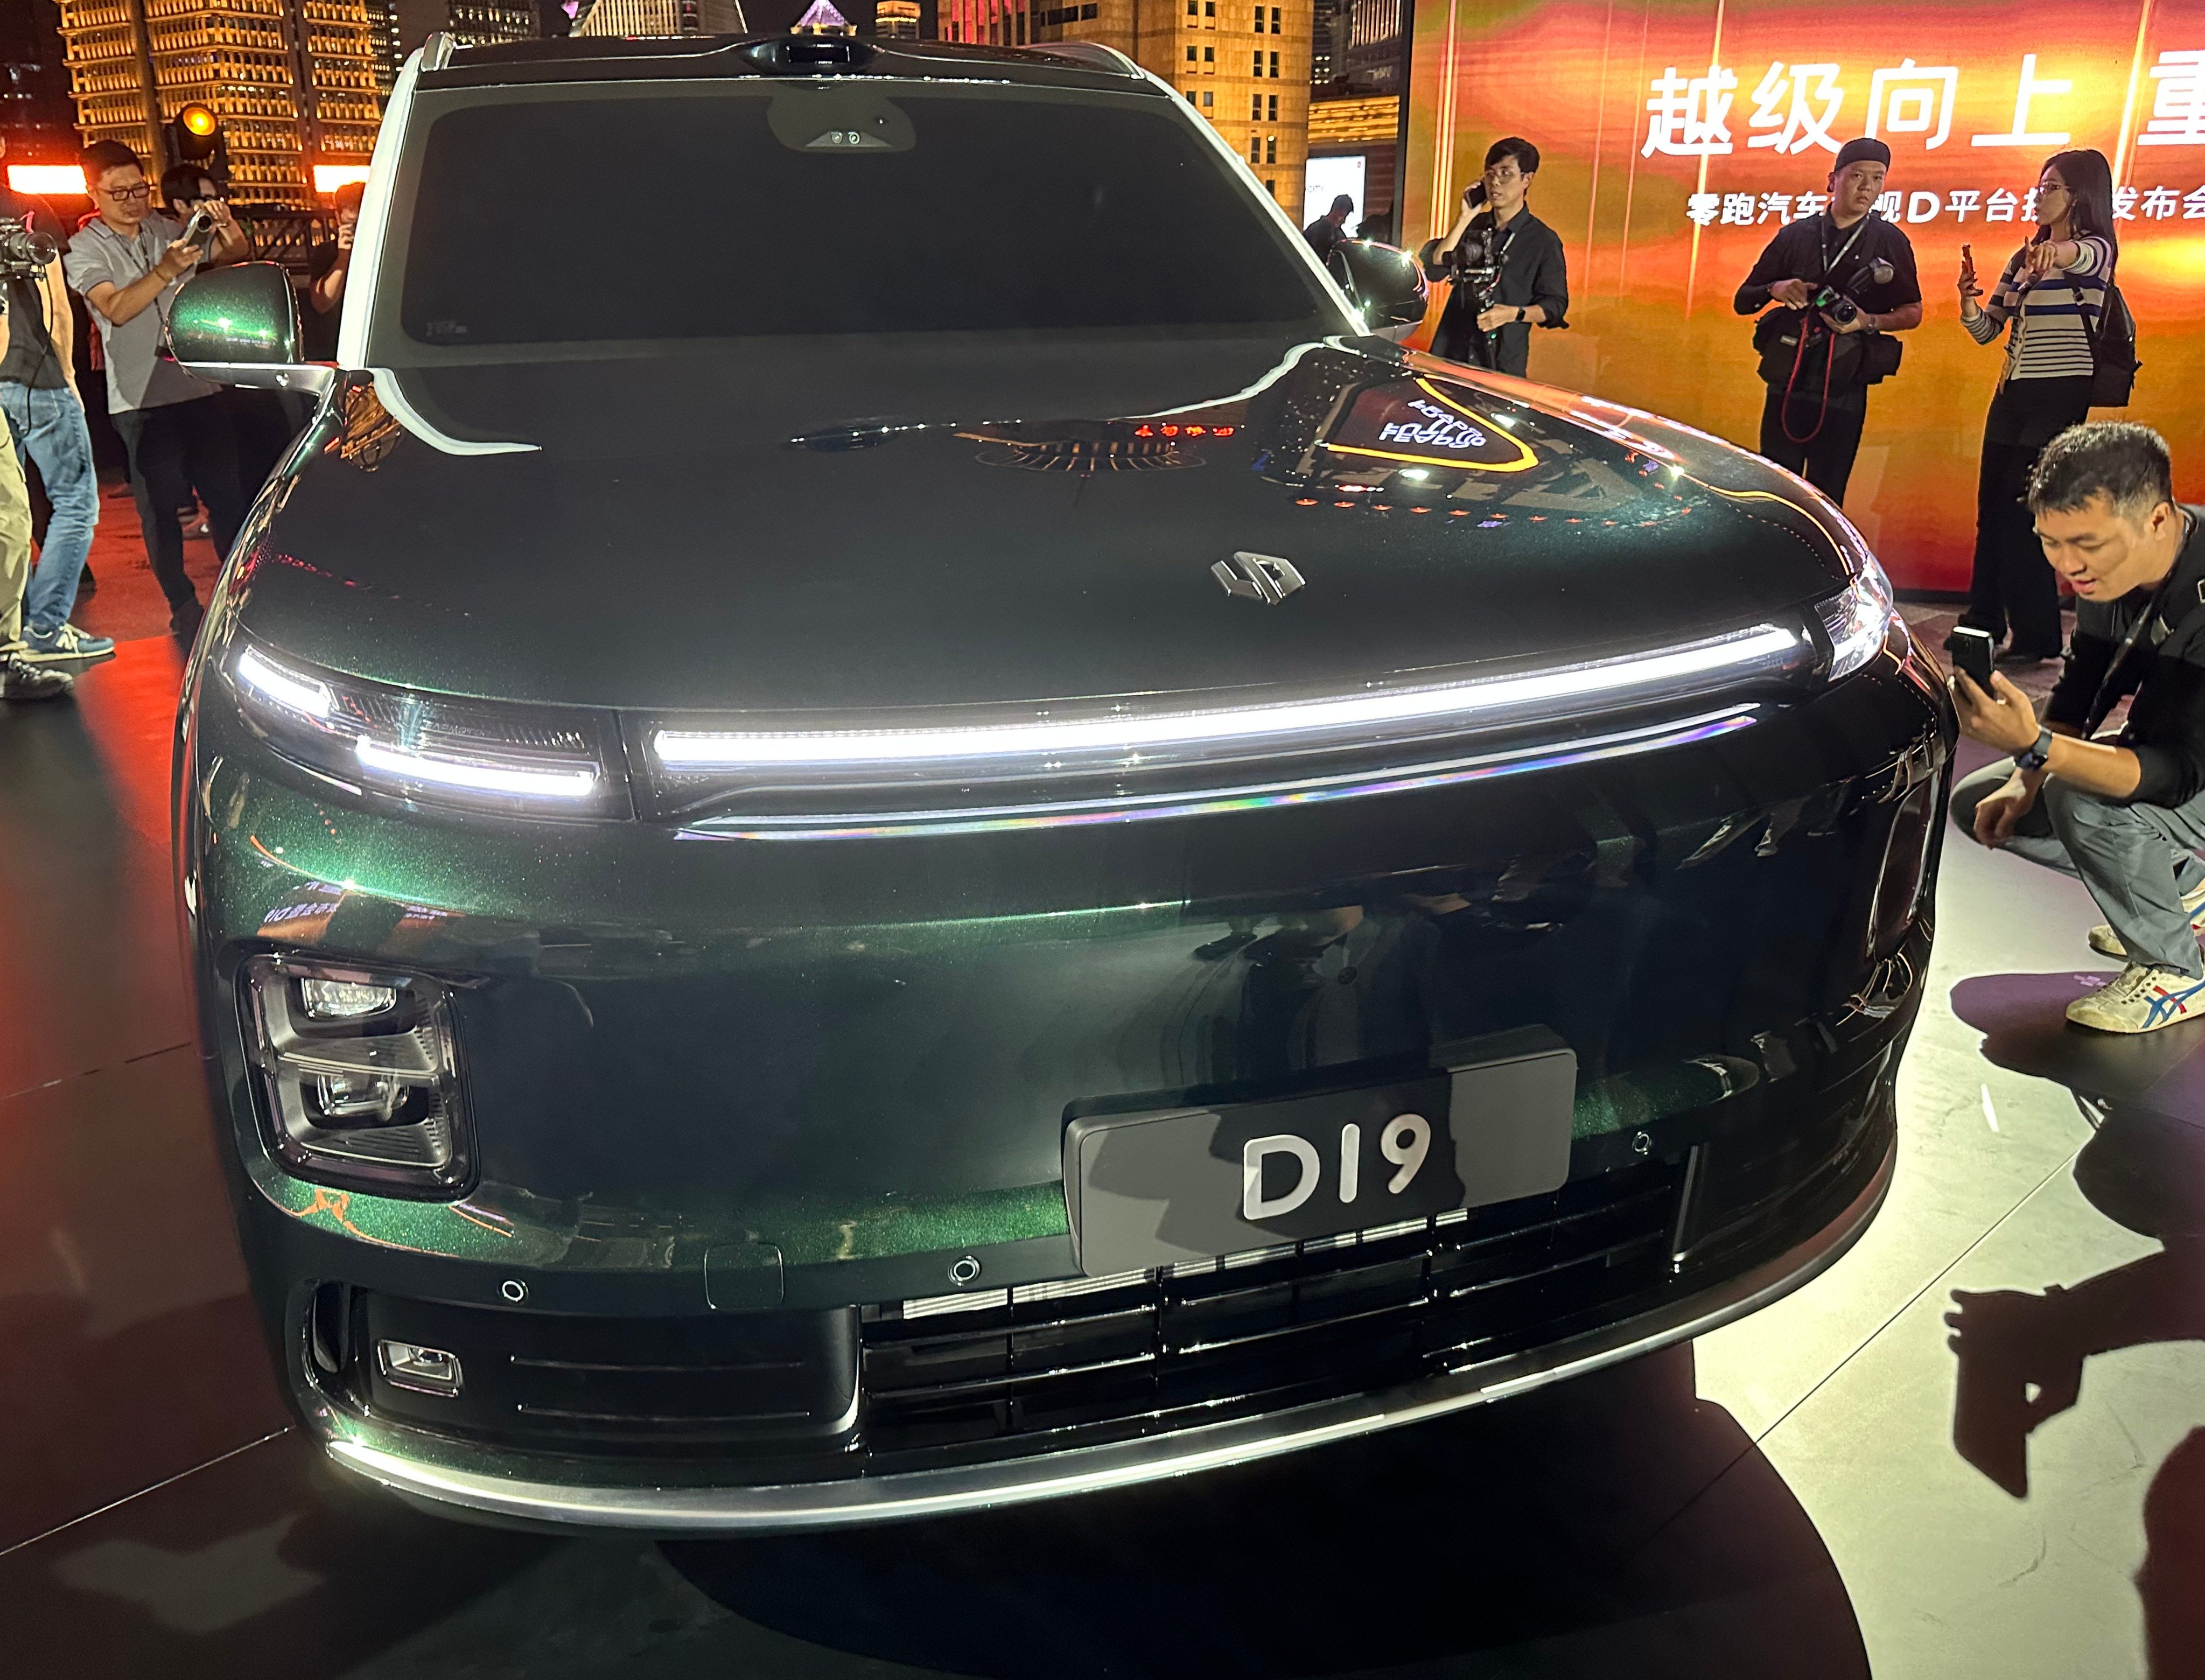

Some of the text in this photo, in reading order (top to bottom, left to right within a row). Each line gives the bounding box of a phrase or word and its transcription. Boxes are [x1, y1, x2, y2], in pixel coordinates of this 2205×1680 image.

[1641, 54, 2072, 158] 越级向上
[1243, 1114, 1431, 1221] D19
